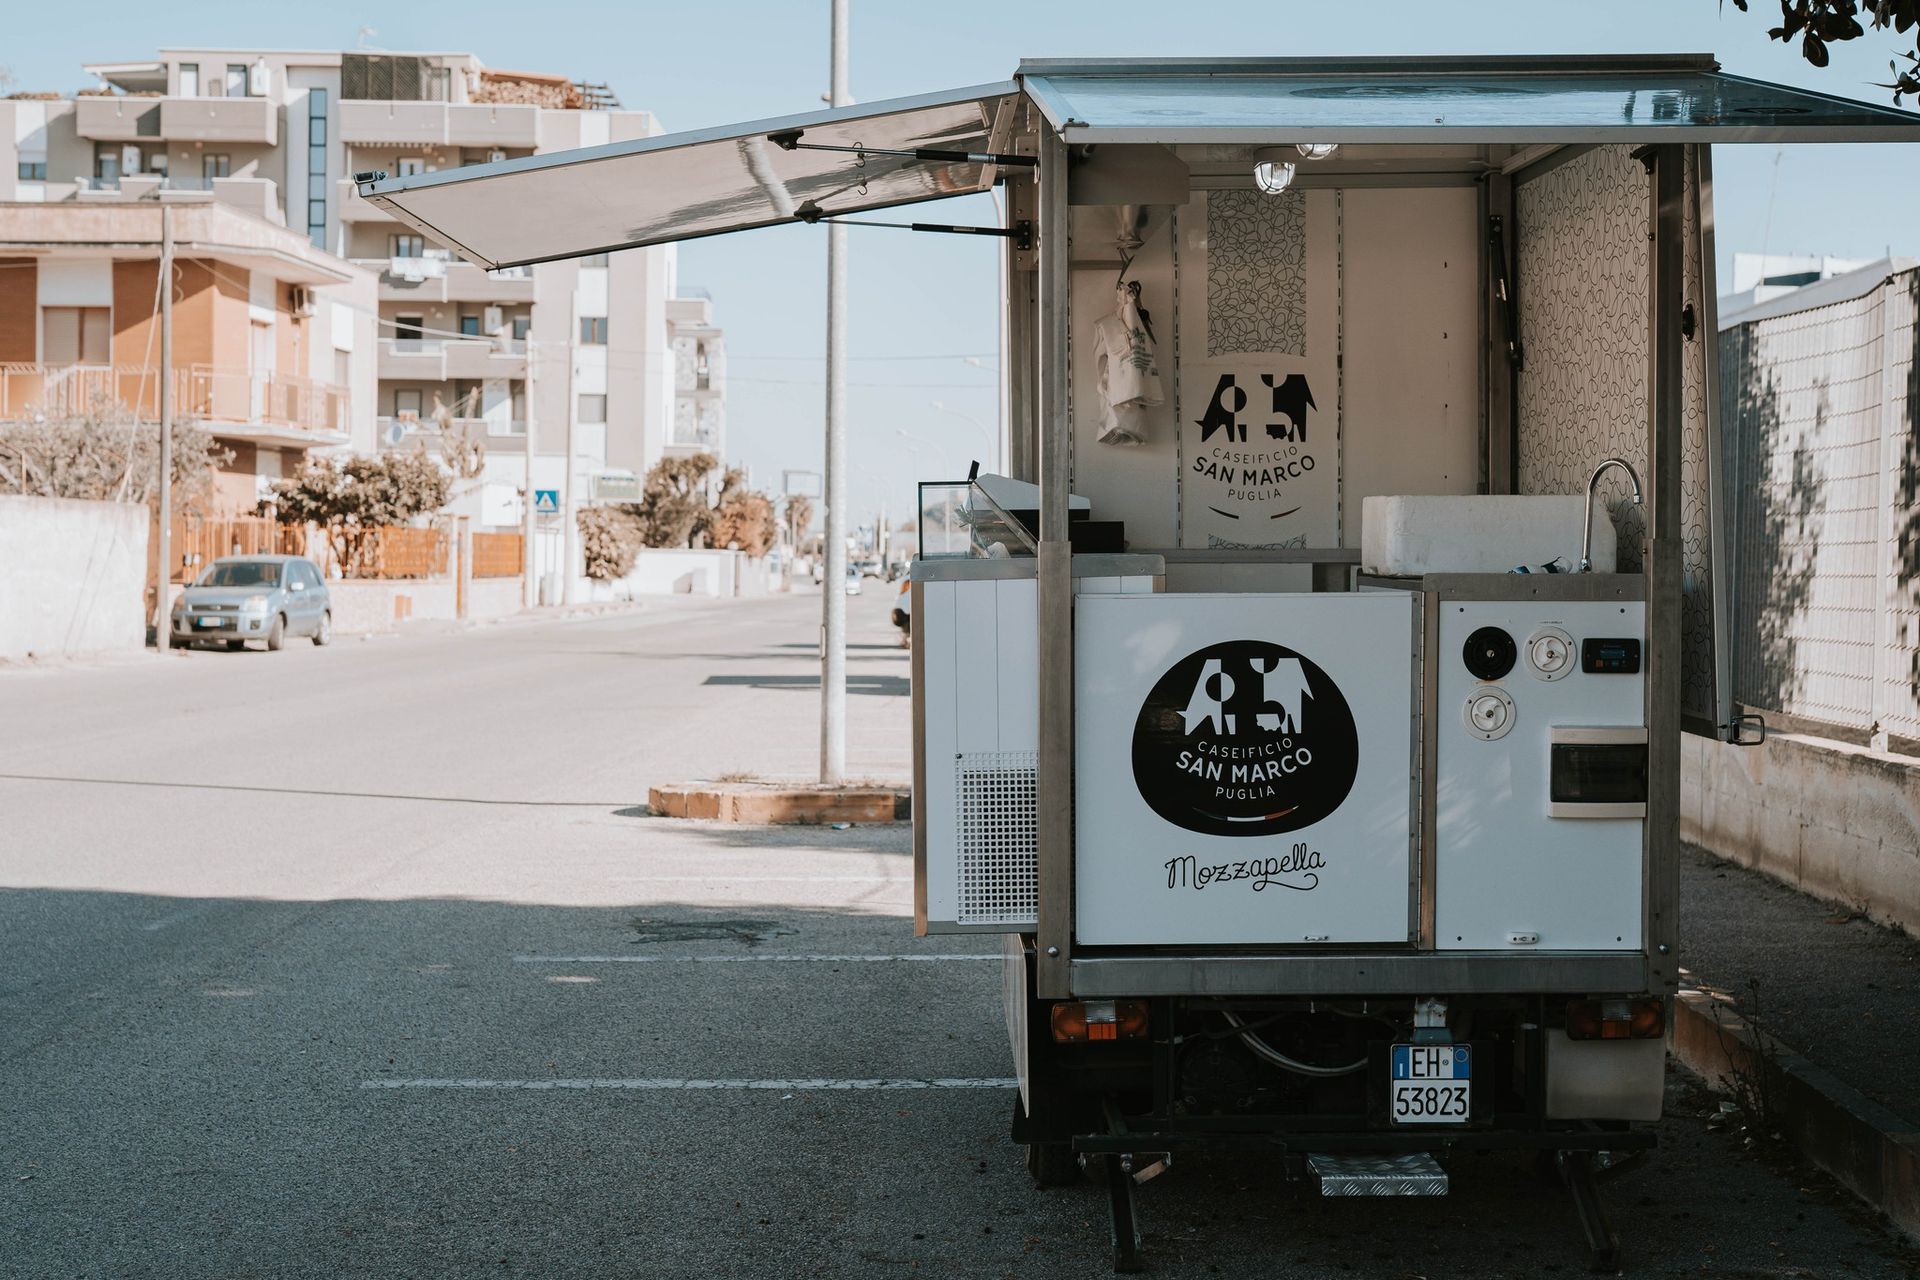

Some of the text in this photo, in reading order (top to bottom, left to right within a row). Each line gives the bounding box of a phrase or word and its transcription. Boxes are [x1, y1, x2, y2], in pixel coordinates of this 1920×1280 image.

[1212, 446, 1298, 464] CASEIFICIO
[1192, 455, 1315, 486] SAN MARCO
[1227, 488, 1282, 501] PUGLIA
[1197, 737, 1292, 759] CASEIFICIO
[1175, 747, 1312, 783] SAN MARCO
[1215, 785, 1275, 800] PUGLIA
[1164, 842, 1326, 892] Mozzapella
[1412, 1048, 1440, 1077] EH
[1396, 1086, 1467, 1116] 53823
